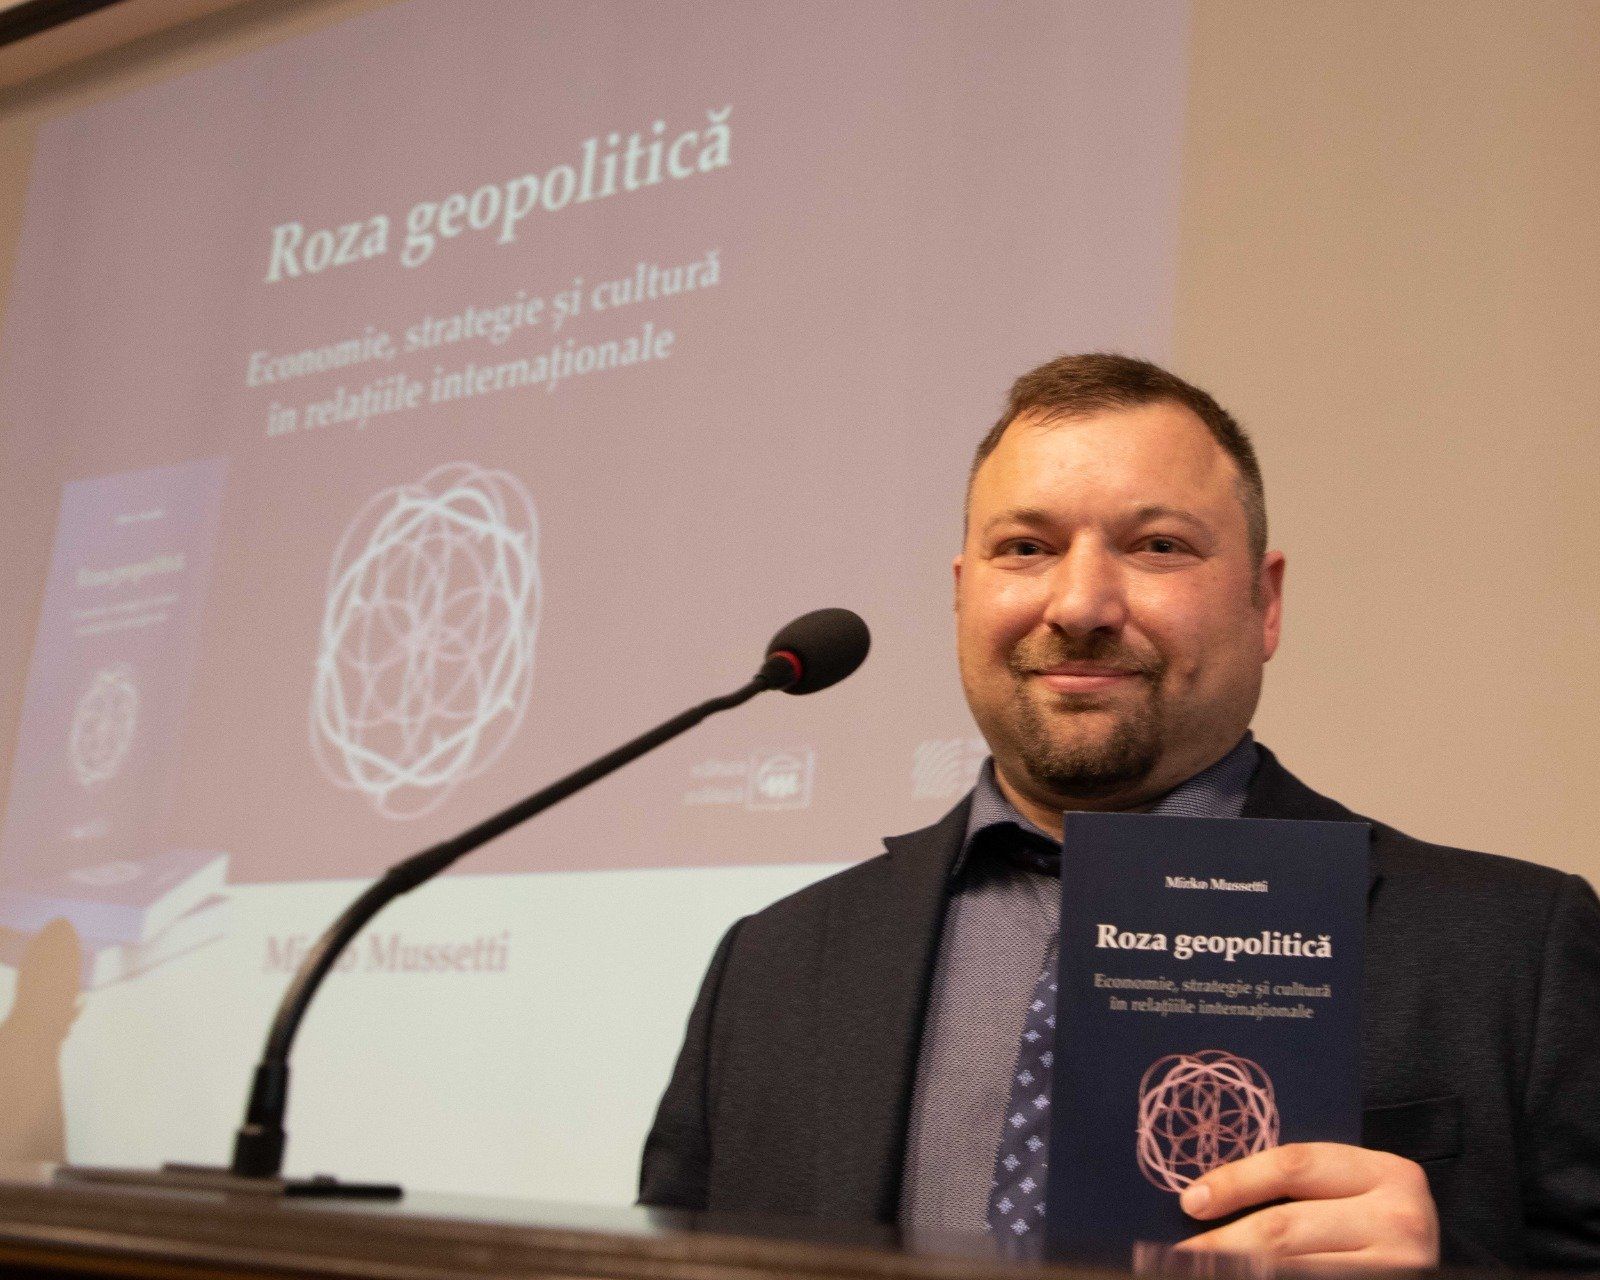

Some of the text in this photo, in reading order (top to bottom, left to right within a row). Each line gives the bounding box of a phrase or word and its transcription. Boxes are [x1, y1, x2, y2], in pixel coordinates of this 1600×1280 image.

[263, 104, 734, 284] Roza geopolitică
[245, 326, 396, 389] Economie,
[403, 291, 544, 349] strategie
[591, 250, 721, 310] cultură
[1164, 876, 1269, 893] Mirko Mussetti
[364, 930, 512, 974] Mussetti
[1095, 923, 1333, 962] Roza geopolitică
[1093, 973, 1179, 993] Economie,
[1182, 976, 1252, 999] strategie
[1272, 982, 1333, 998] cultură
